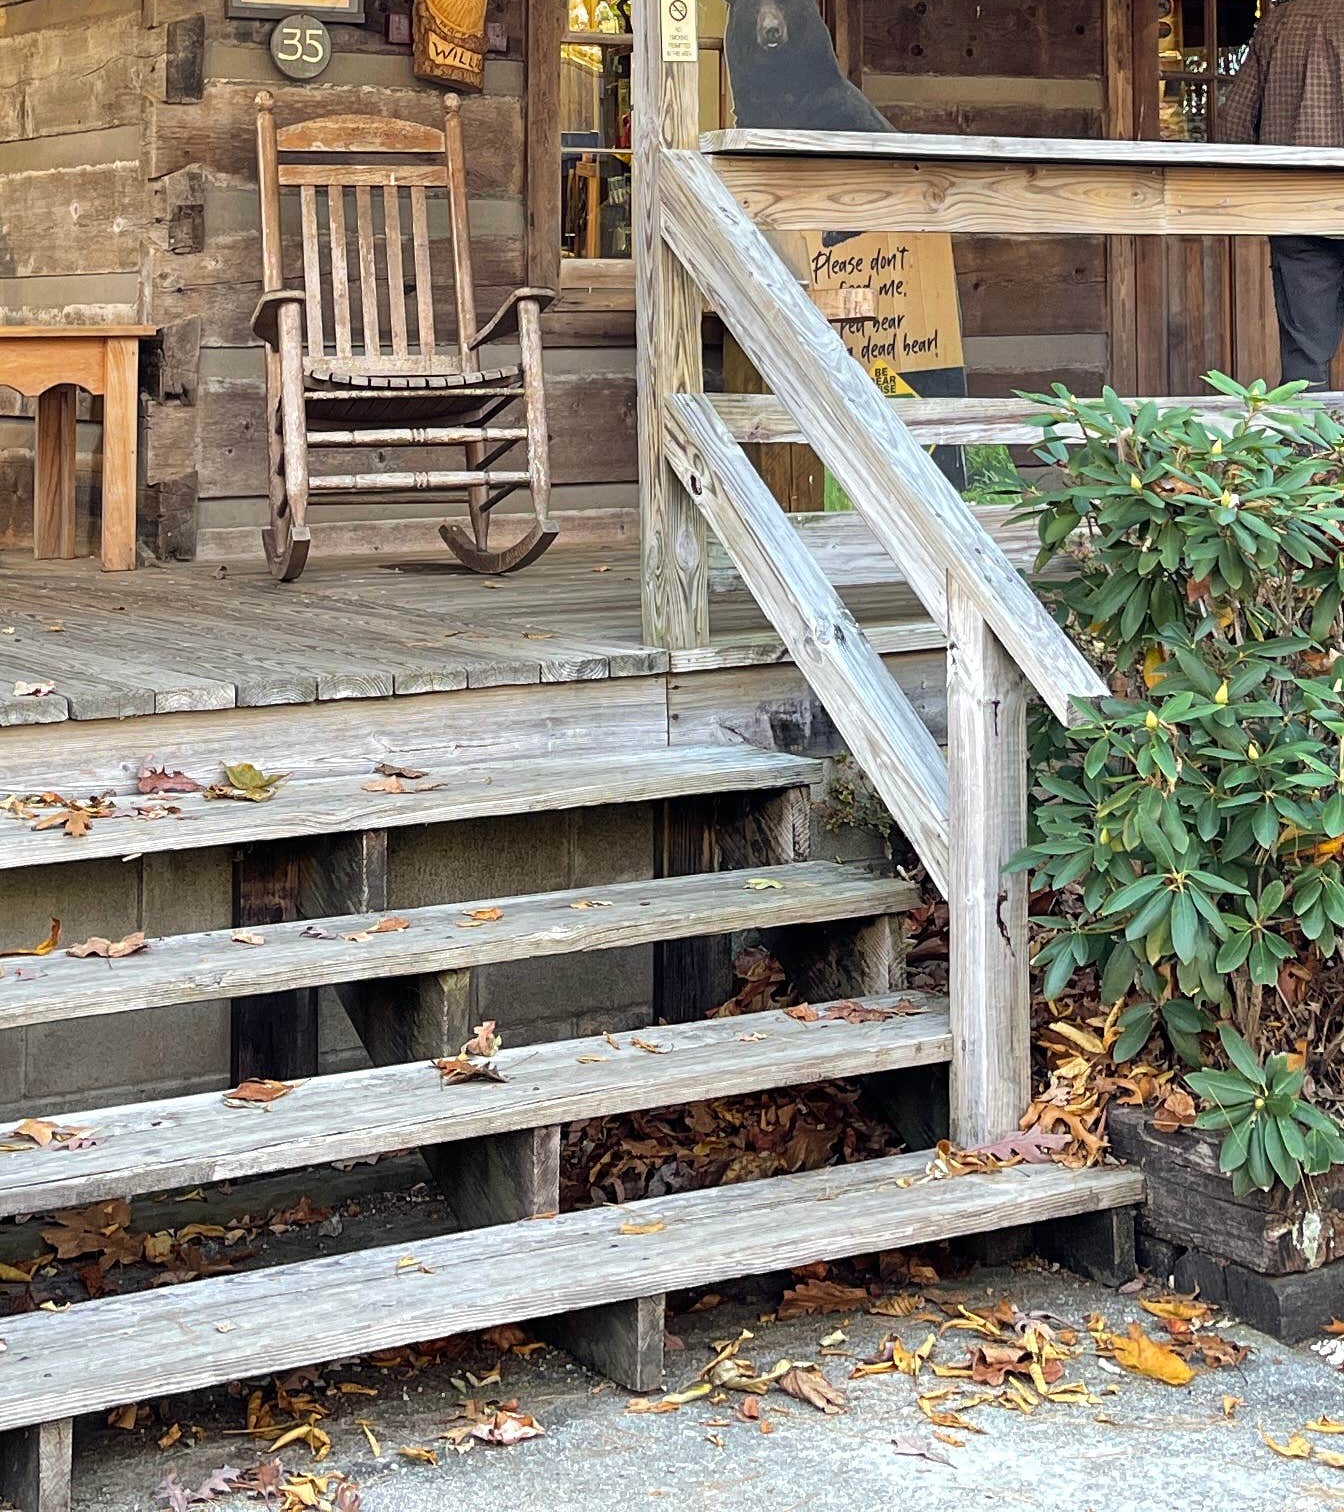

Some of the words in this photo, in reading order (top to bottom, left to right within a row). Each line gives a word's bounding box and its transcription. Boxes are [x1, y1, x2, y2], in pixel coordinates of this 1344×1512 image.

[277, 28, 324, 63] 35
[812, 249, 863, 284] Please
[870, 246, 909, 275] don't
[861, 333, 897, 363] dead
[903, 329, 939, 358] bear!
[875, 367, 888, 377] BE
[880, 384, 896, 394] ISE
